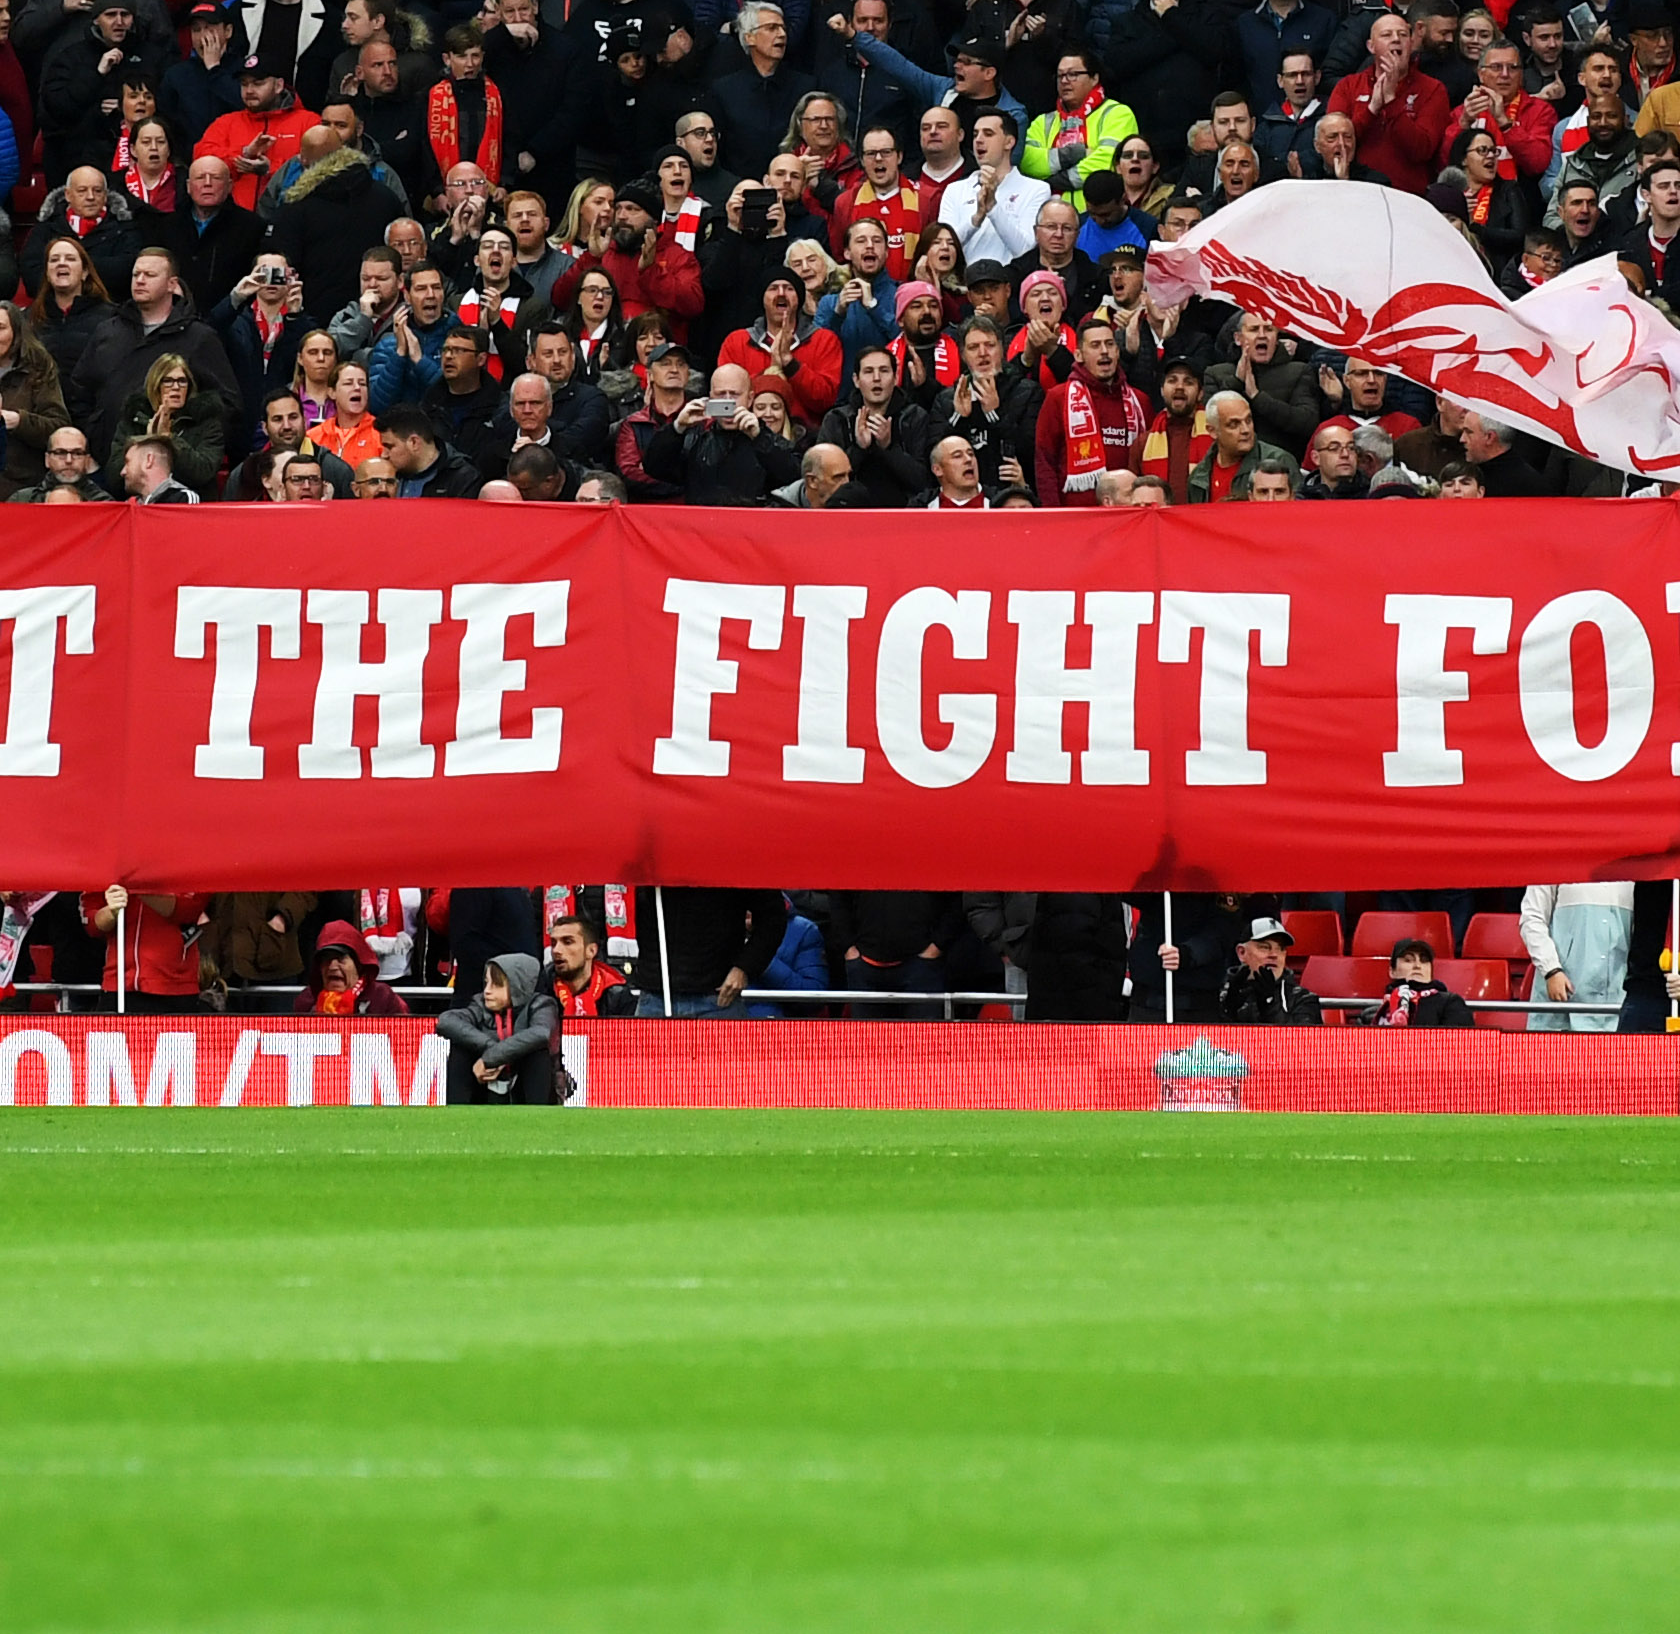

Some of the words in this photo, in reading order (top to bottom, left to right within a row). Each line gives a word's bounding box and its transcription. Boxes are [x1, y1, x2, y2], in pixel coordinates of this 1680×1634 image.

[429, 98, 442, 141] ALONE
[117, 136, 130, 168] ALONE
[1101, 427, 1126, 437] ndard
[1102, 436, 1126, 447] tered
[175, 580, 570, 779] THE
[653, 578, 1290, 788] FIGHT
